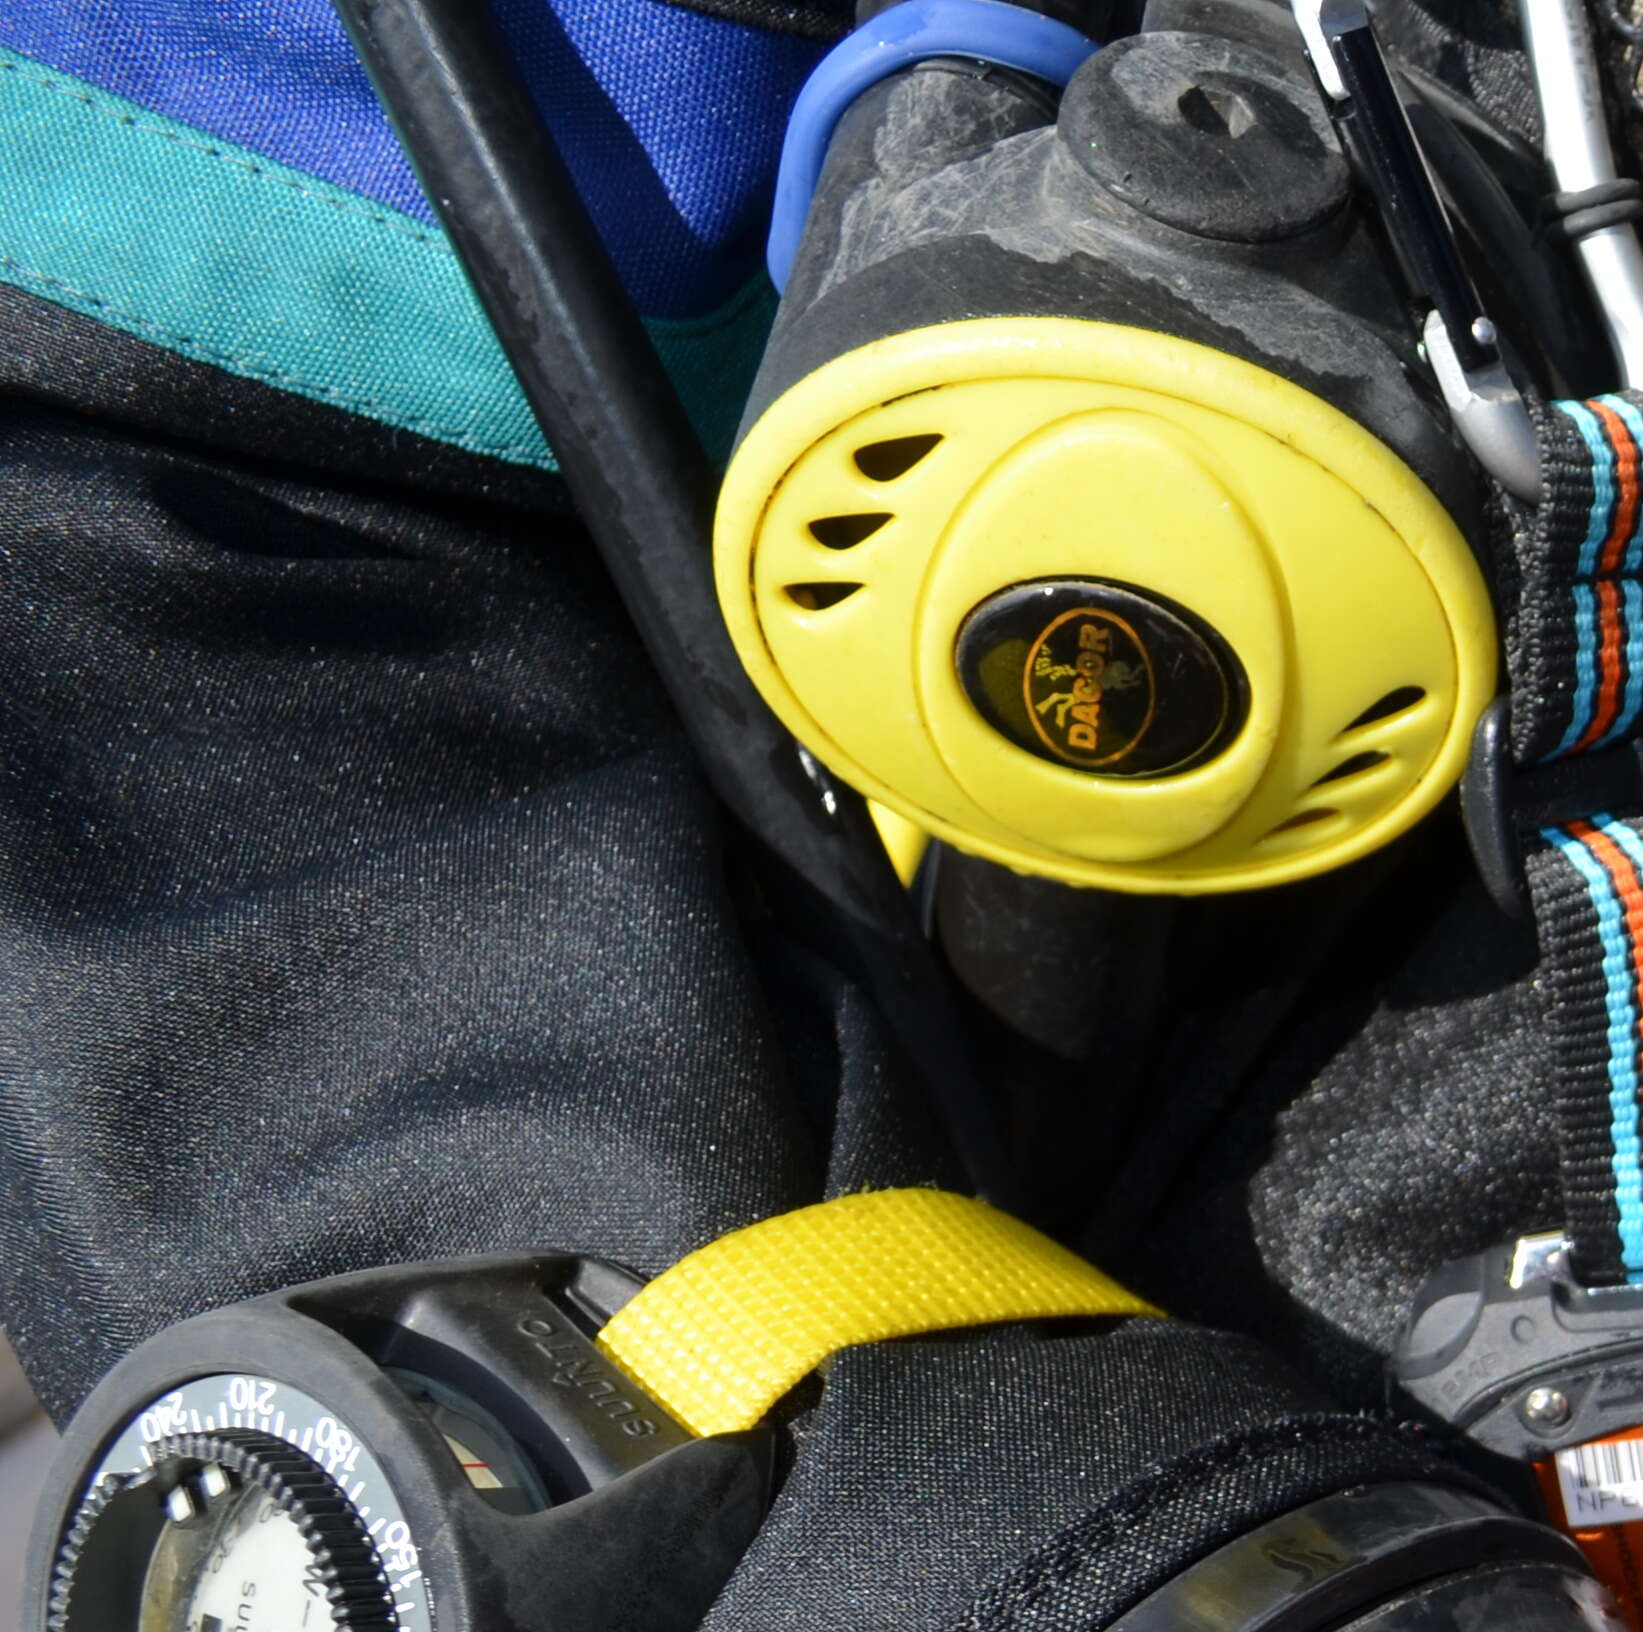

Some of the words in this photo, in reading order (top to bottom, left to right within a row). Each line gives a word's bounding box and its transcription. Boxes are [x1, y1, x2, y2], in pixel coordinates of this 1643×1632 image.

[1068, 624, 1111, 749] DACOR
[229, 1377, 276, 1415] 210
[516, 1318, 658, 1437] SUUNTO
[140, 1391, 184, 1442] 240
[315, 1417, 361, 1472] 180
[384, 1521, 422, 1588] 150
